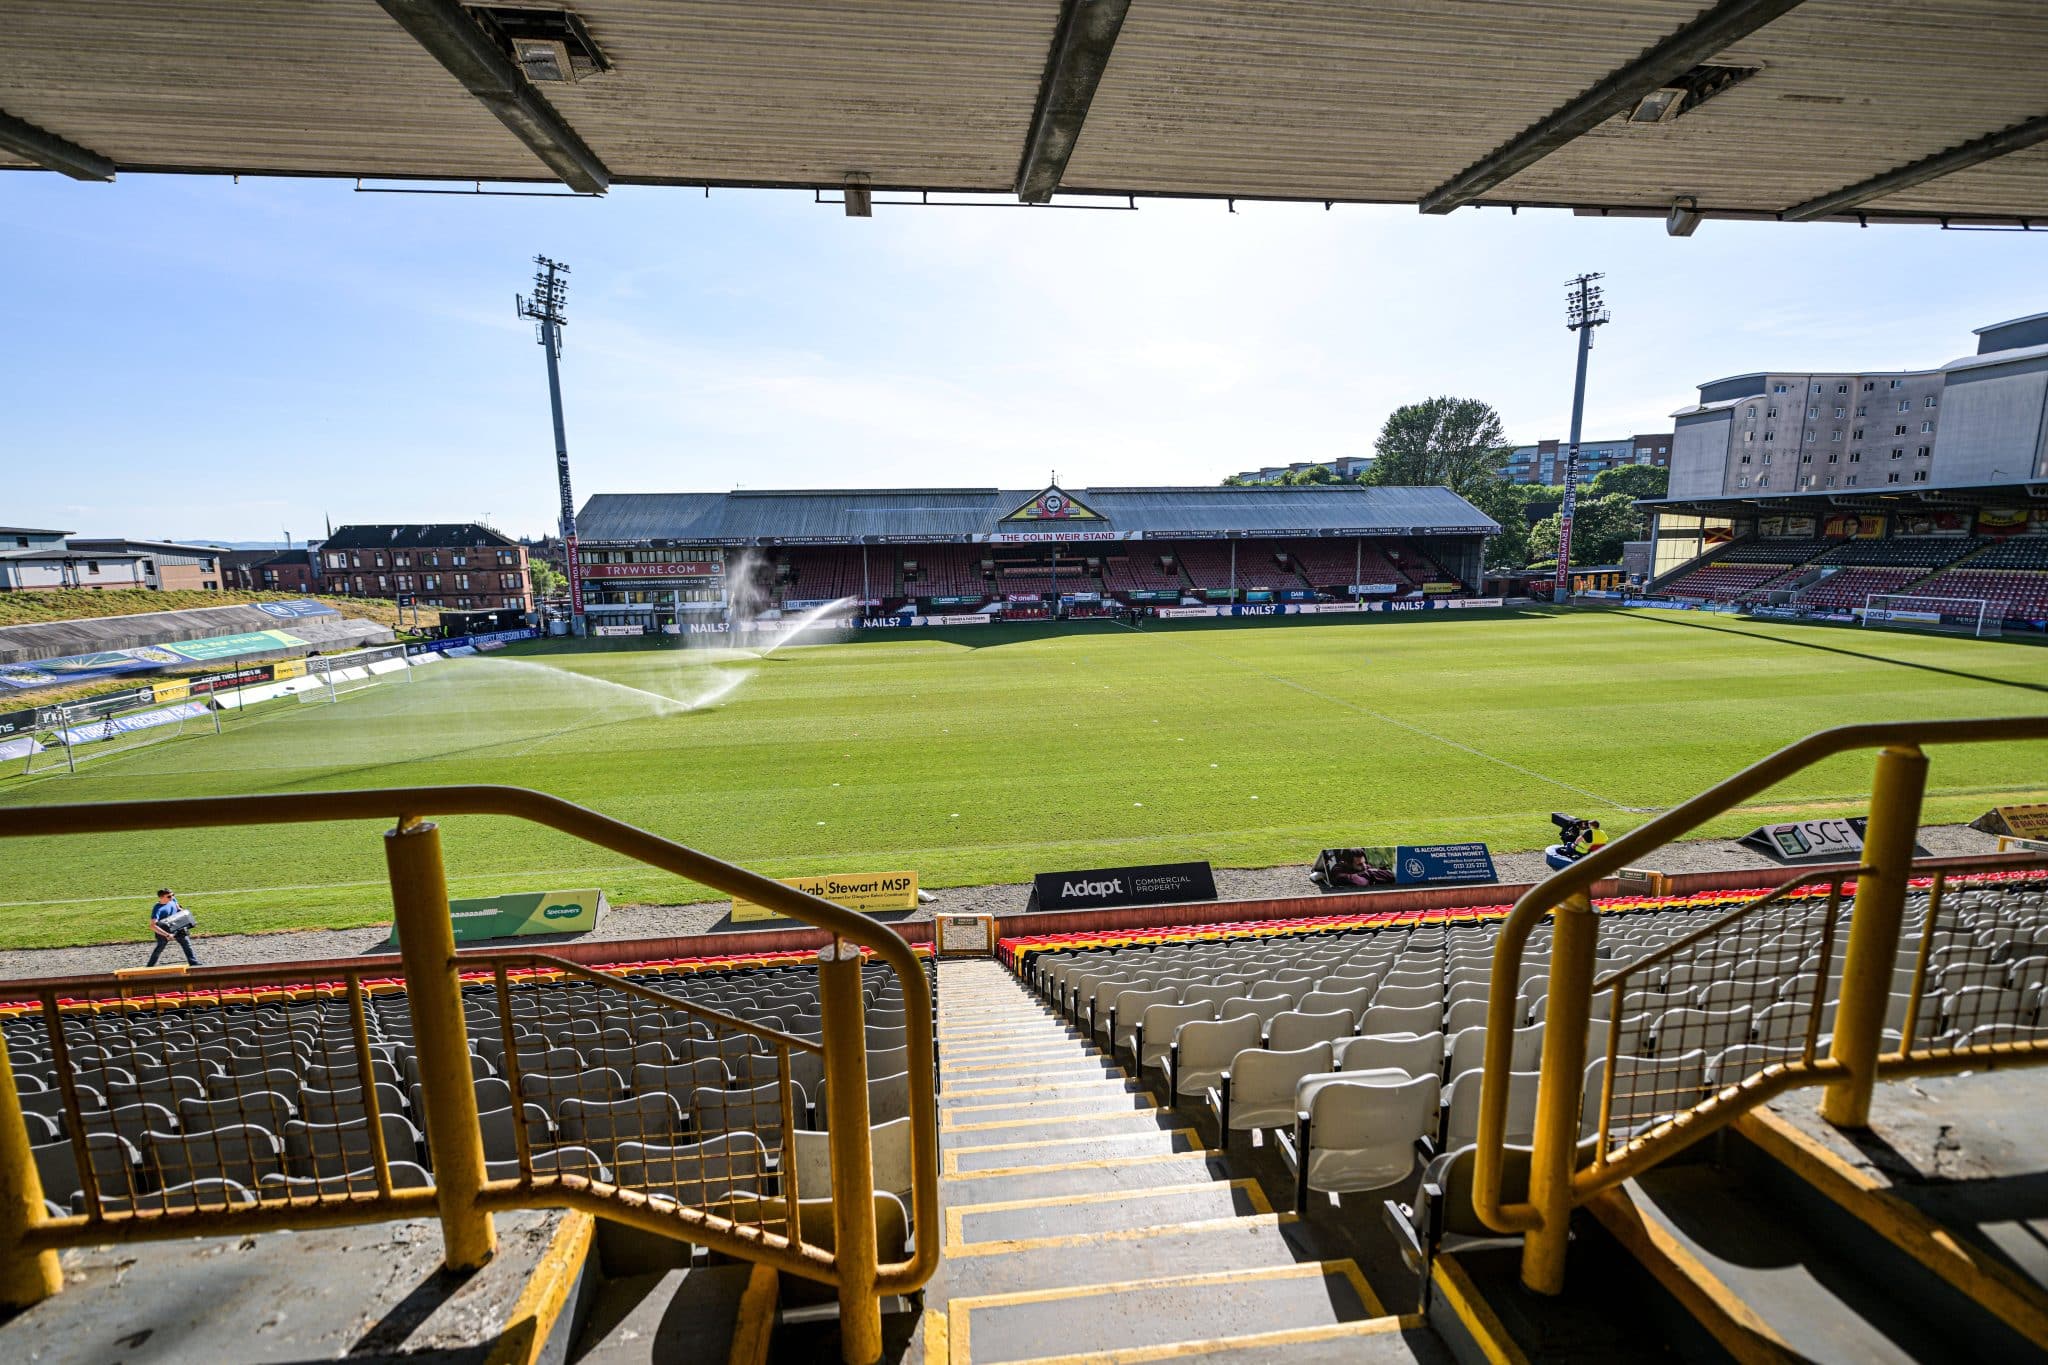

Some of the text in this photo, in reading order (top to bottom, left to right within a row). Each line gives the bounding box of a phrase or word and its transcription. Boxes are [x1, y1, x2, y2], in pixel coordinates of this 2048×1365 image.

[1023, 533, 1053, 541] COLIN
[1083, 532, 1115, 540] STAND
[606, 565, 696, 575] TRYWYRE.COM
[1241, 605, 1276, 615] NAILS?
[1391, 600, 1425, 610] NAILS?
[863, 617, 901, 628] NAILS?
[690, 623, 730, 633] NAILS?
[222, 670, 254, 680] THOUANDS
[228, 677, 244, 685] YOR
[1804, 822, 1851, 845] SCF
[828, 881, 878, 894] Stewart
[882, 878, 911, 890] MSP
[1061, 875, 1191, 898] Adapt COMMERCIAL
[1136, 882, 1181, 892] PROPERTY
[546, 907, 580, 916] Specsavers
